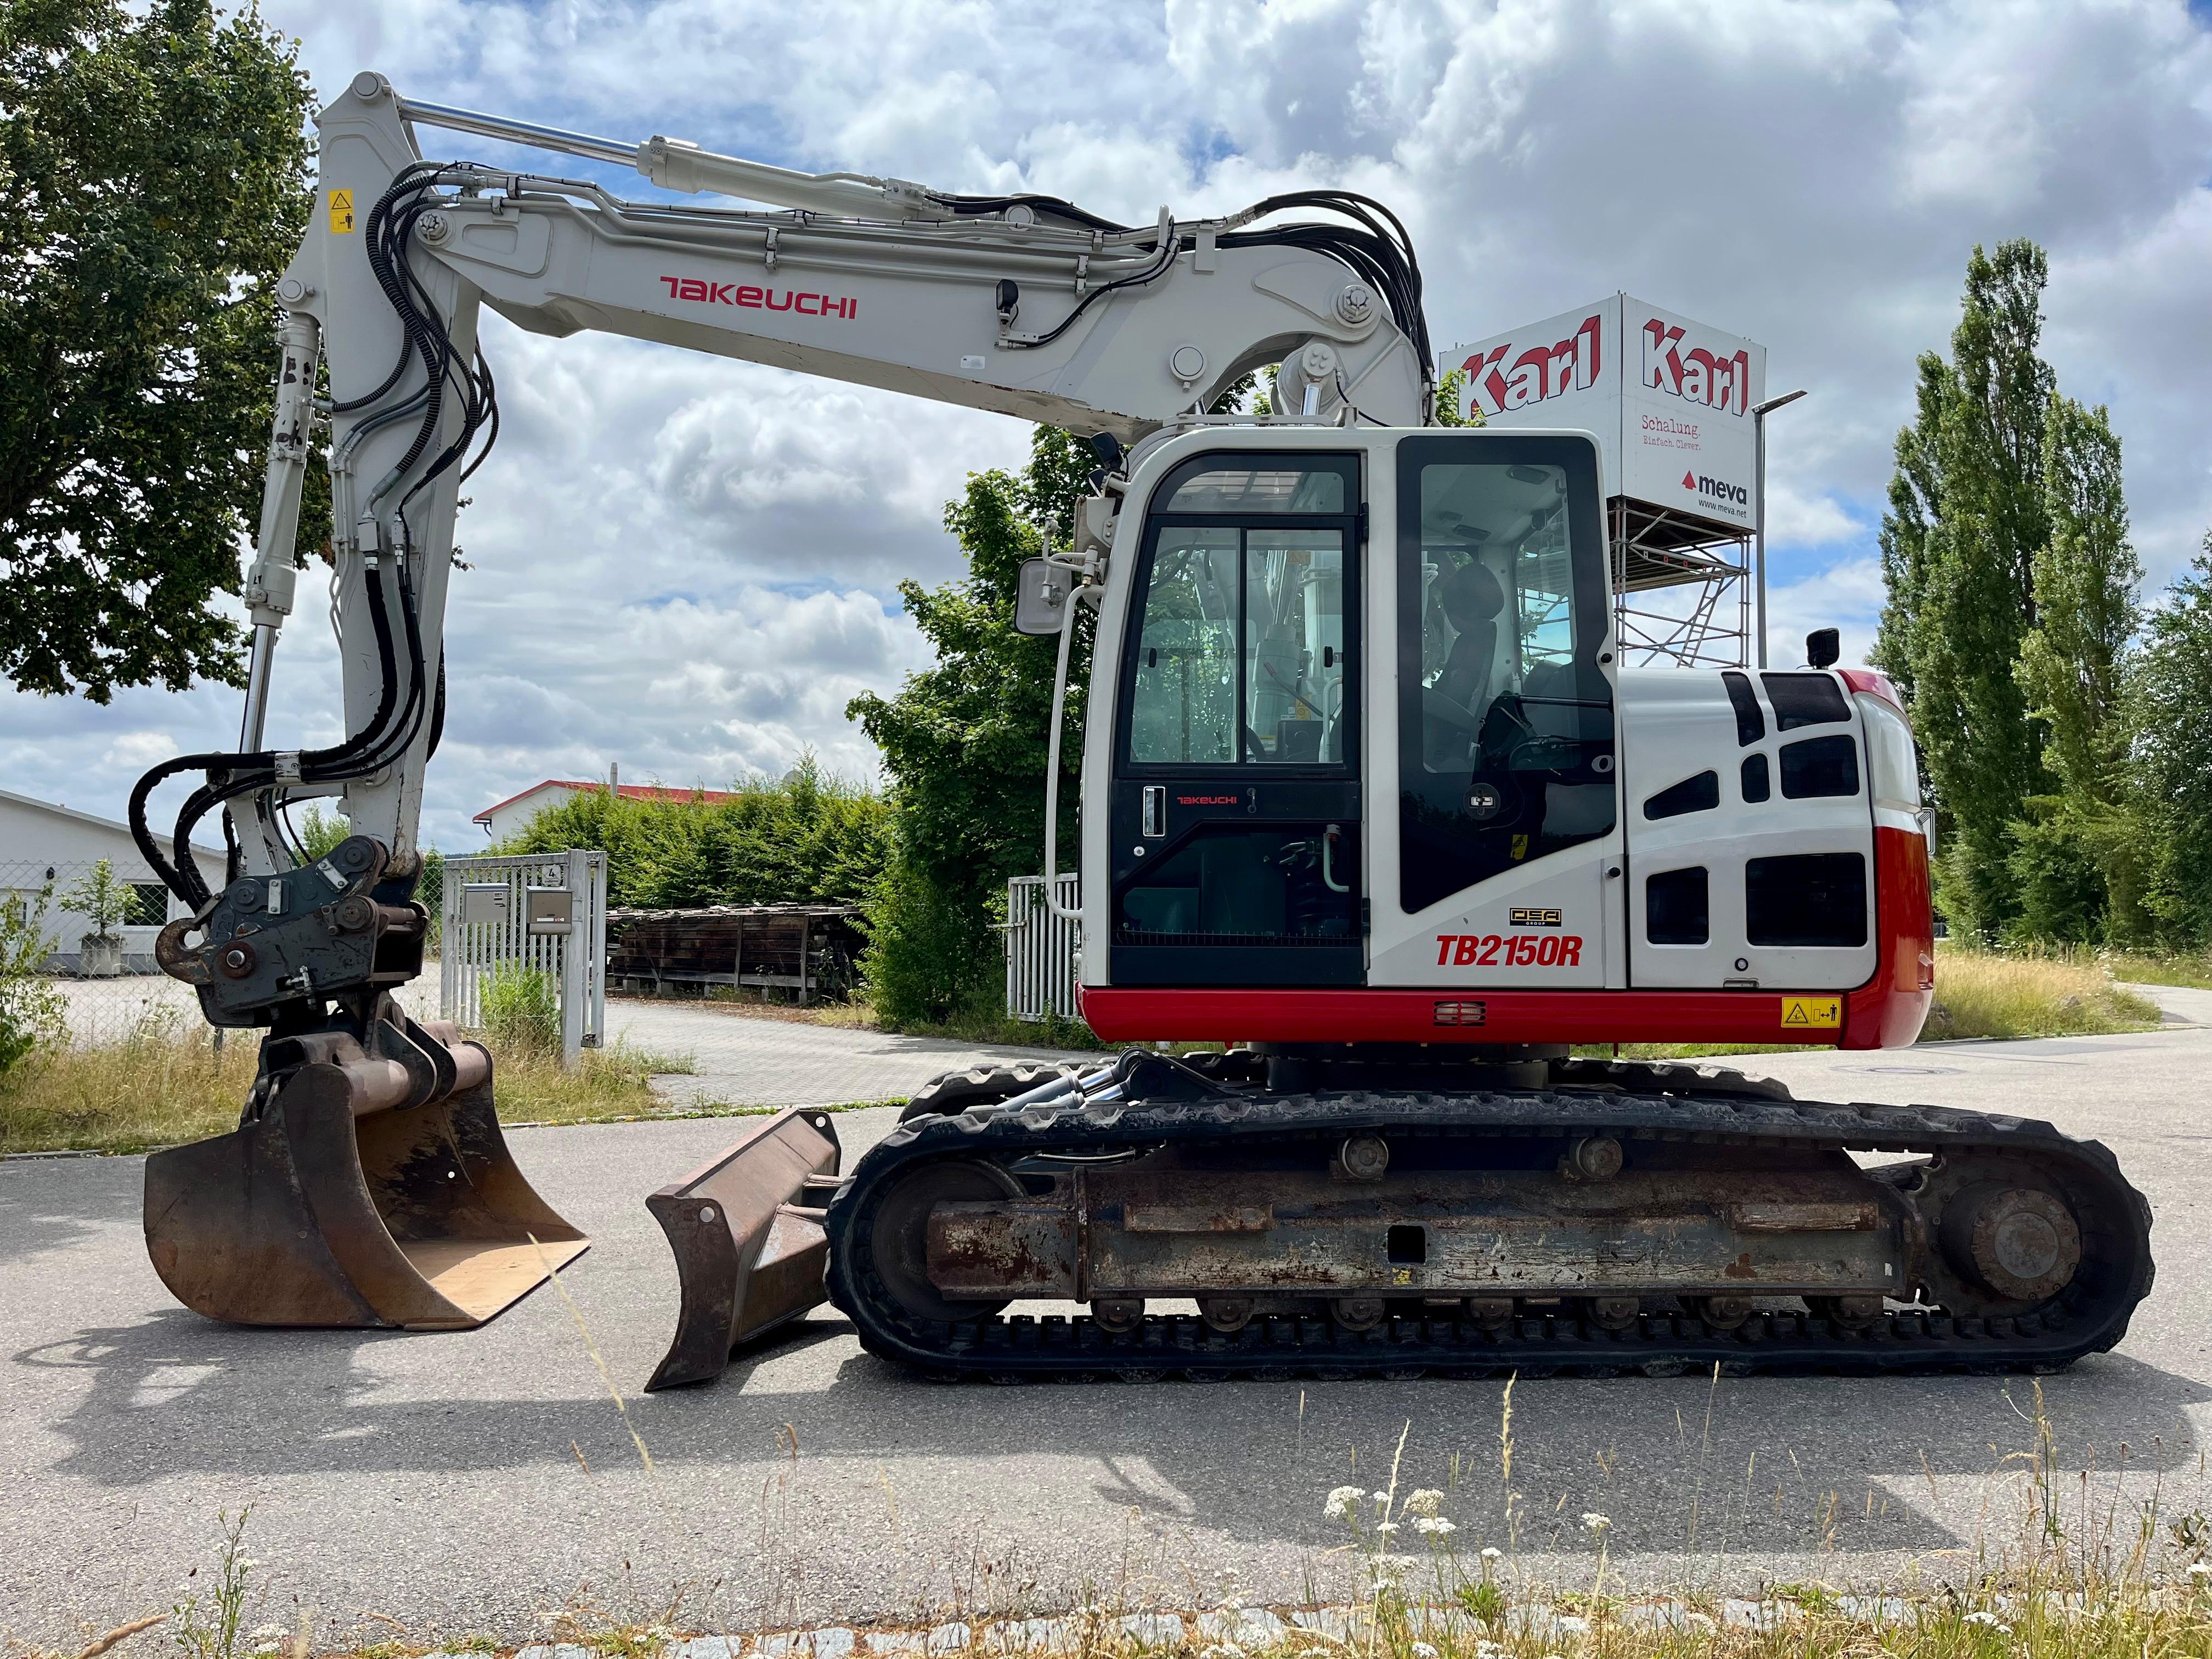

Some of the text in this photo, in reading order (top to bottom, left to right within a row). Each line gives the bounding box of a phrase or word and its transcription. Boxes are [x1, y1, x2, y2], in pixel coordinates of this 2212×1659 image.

[1458, 314, 1600, 419] Karl
[1643, 318, 1748, 417] Karl
[1642, 415, 1701, 439] Schalung.
[1643, 435, 1701, 450] Einfach. Clever.
[1699, 476, 1747, 505] meva
[1699, 499, 1747, 518] www.meva.net
[549, 868, 555, 877] 4
[1436, 935, 1583, 966] TB2150R
